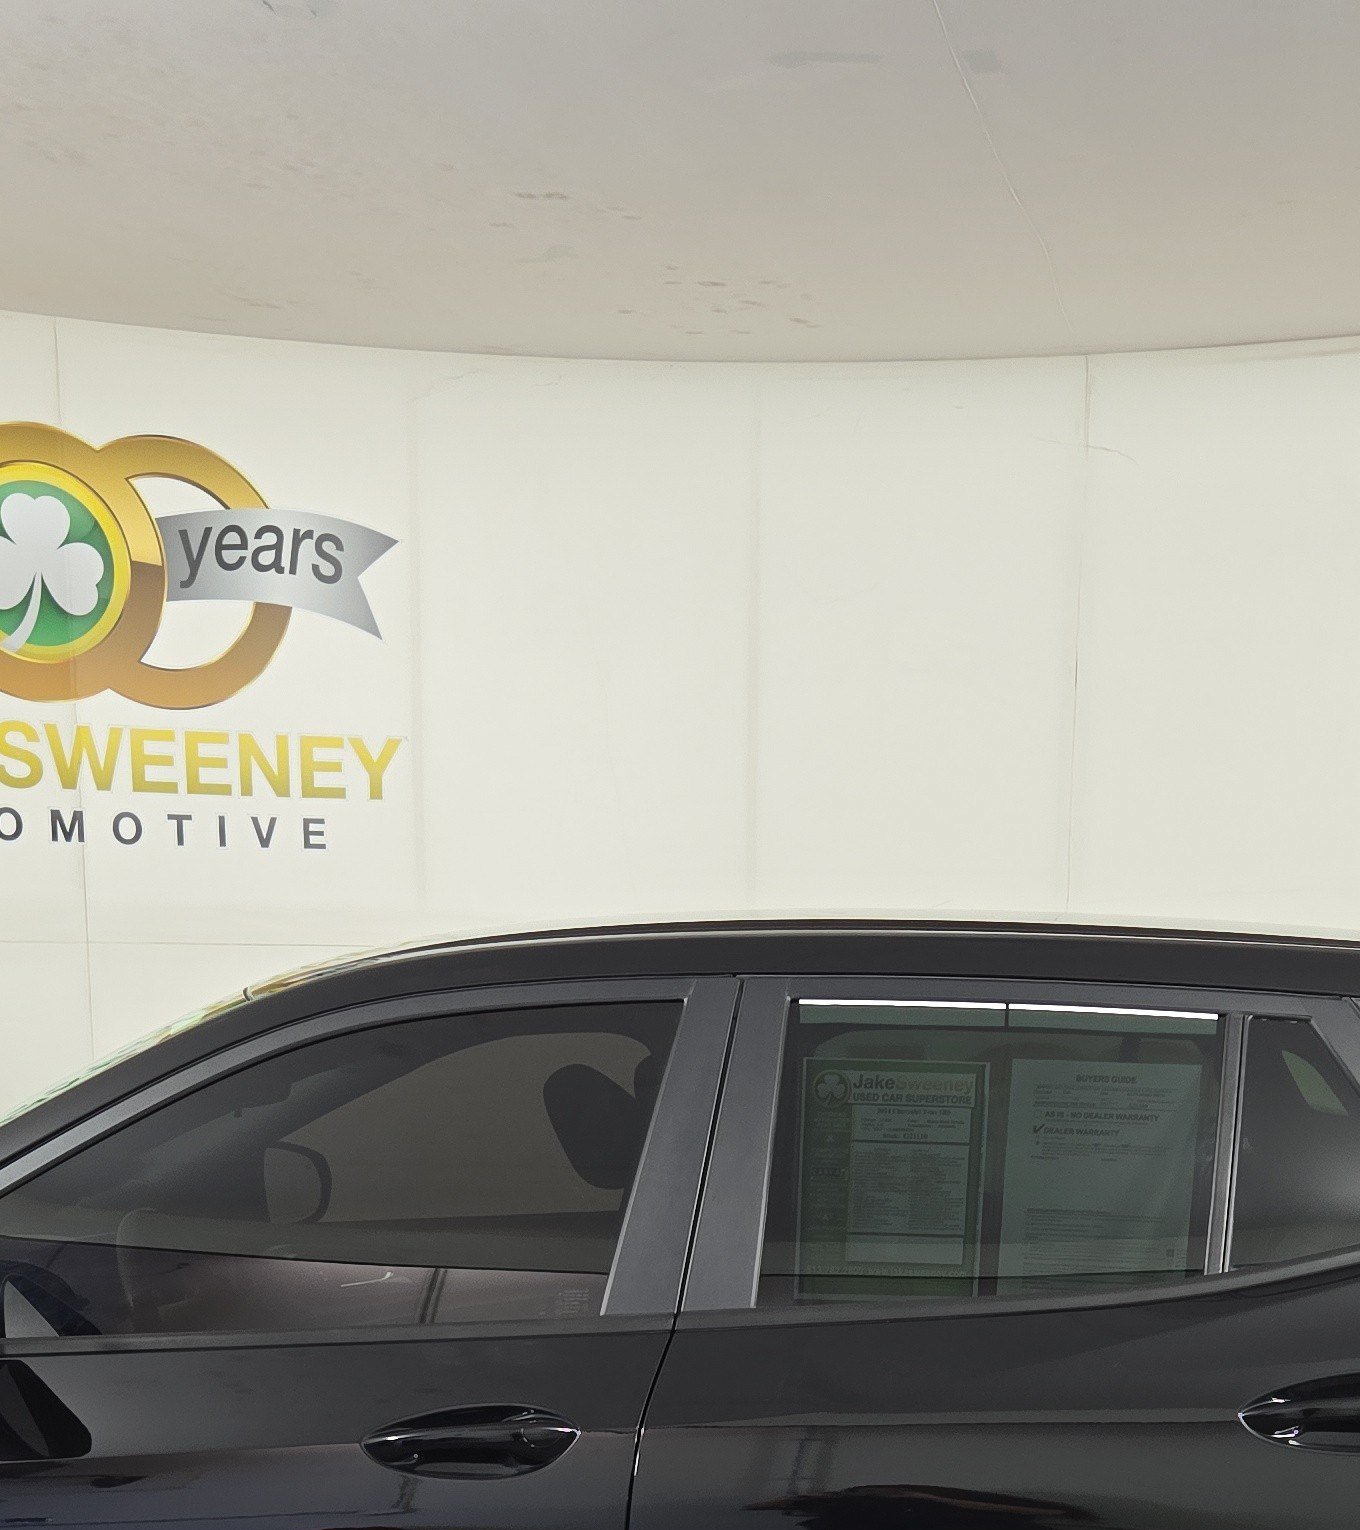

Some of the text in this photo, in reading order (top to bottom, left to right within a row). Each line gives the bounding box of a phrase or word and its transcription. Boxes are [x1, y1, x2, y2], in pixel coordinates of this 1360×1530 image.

[178, 521, 344, 588] years
[853, 1073, 895, 1090] Jake
[1075, 1074, 1138, 1084] BUYERS GUIDE
[852, 1092, 972, 1105] USED CAR SUPERSTORE
[1083, 1112, 1114, 1120] DEALER
[1115, 1113, 1160, 1121] WARRANTY
[1043, 1126, 1074, 1134] DEALER
